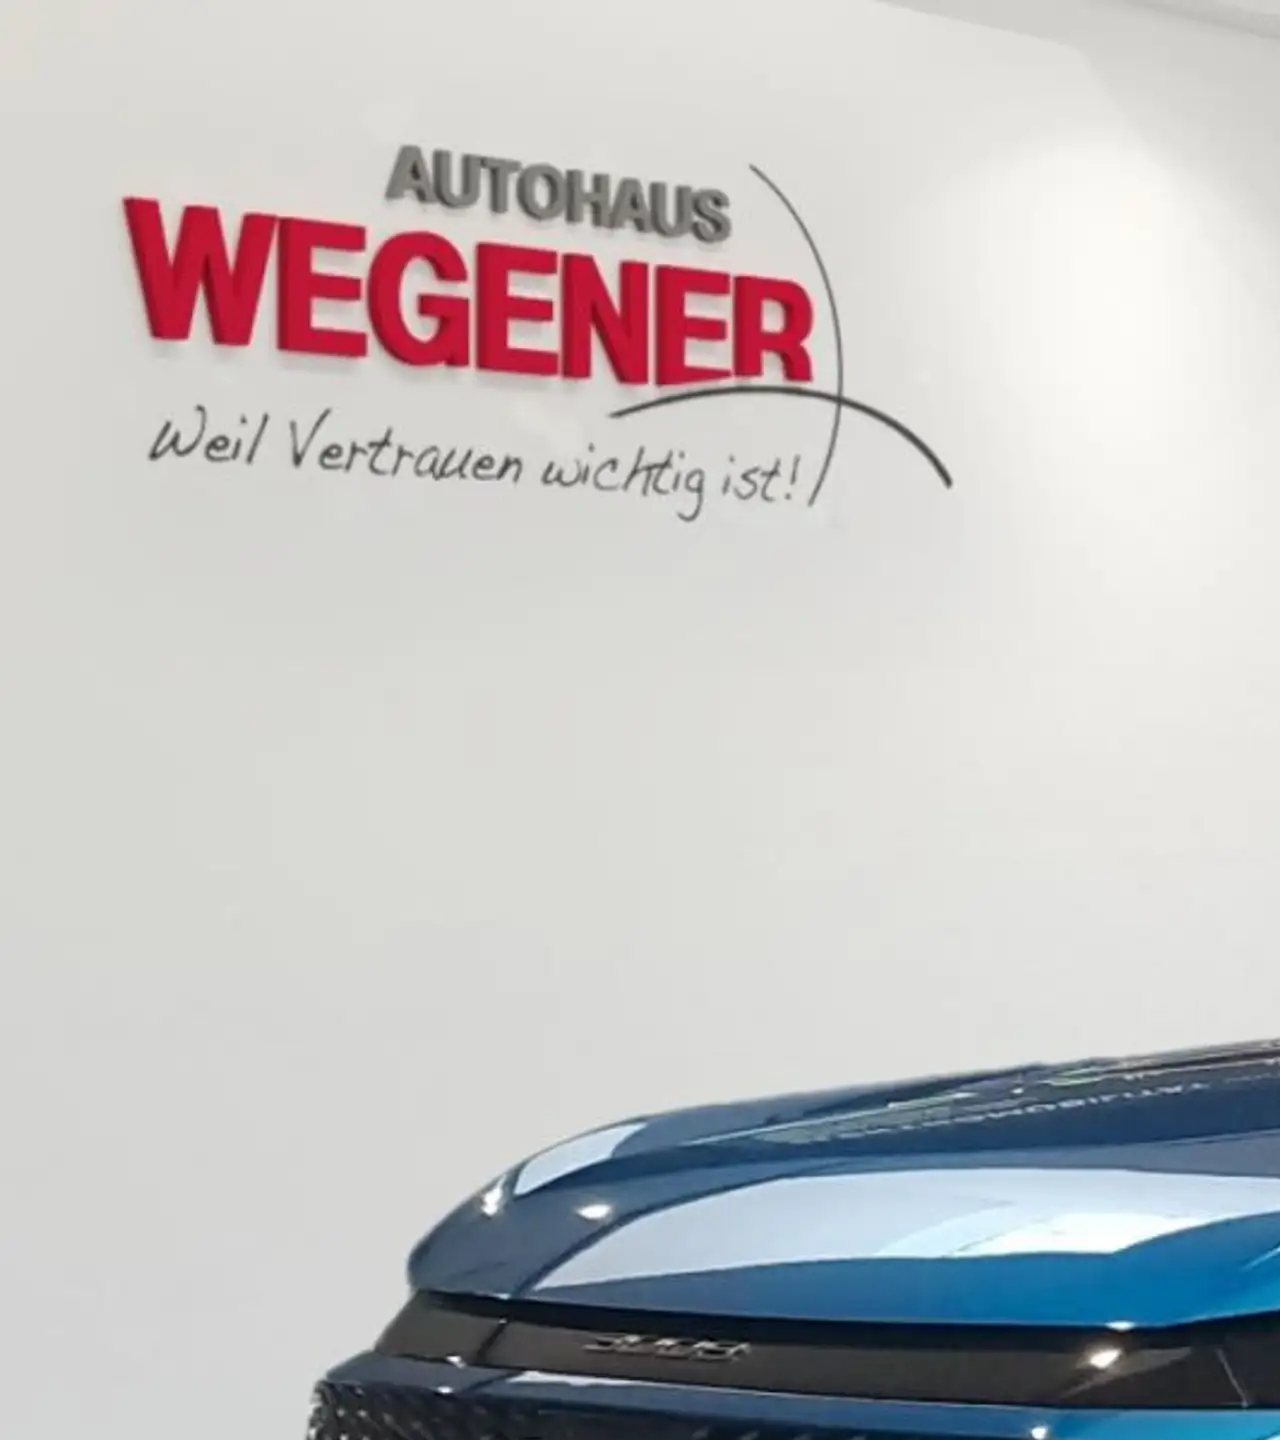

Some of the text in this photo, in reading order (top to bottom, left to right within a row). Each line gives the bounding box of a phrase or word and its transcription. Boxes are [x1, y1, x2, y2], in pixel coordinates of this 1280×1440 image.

[385, 146, 731, 243] AUTOHAUS
[124, 197, 814, 386] WEGENER
[148, 405, 798, 522] Weil Vertrauen wichtig ist!
